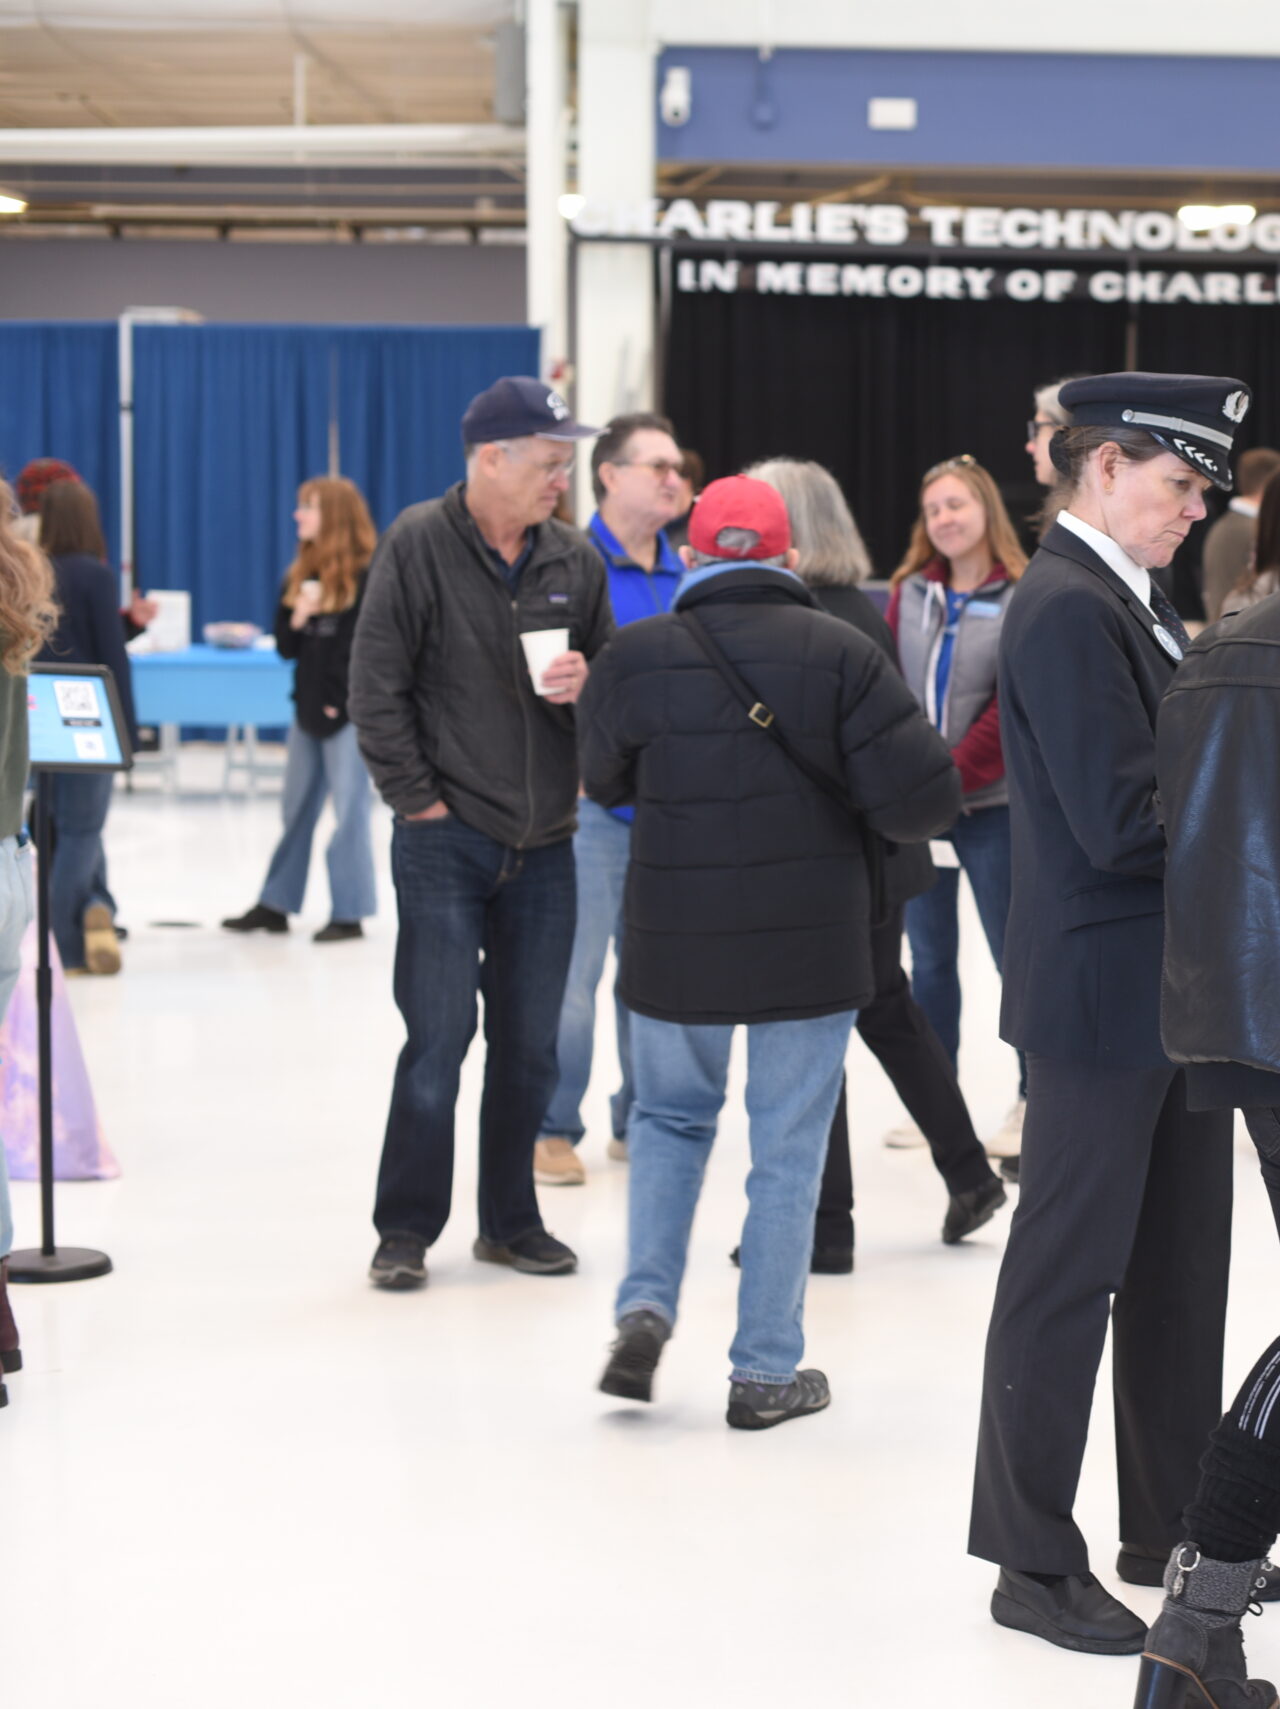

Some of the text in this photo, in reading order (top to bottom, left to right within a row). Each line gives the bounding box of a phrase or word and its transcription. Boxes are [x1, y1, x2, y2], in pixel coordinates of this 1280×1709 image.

[677, 259, 739, 292] IN
[756, 261, 994, 299] MEMORY
[1005, 269, 1076, 302] OF
